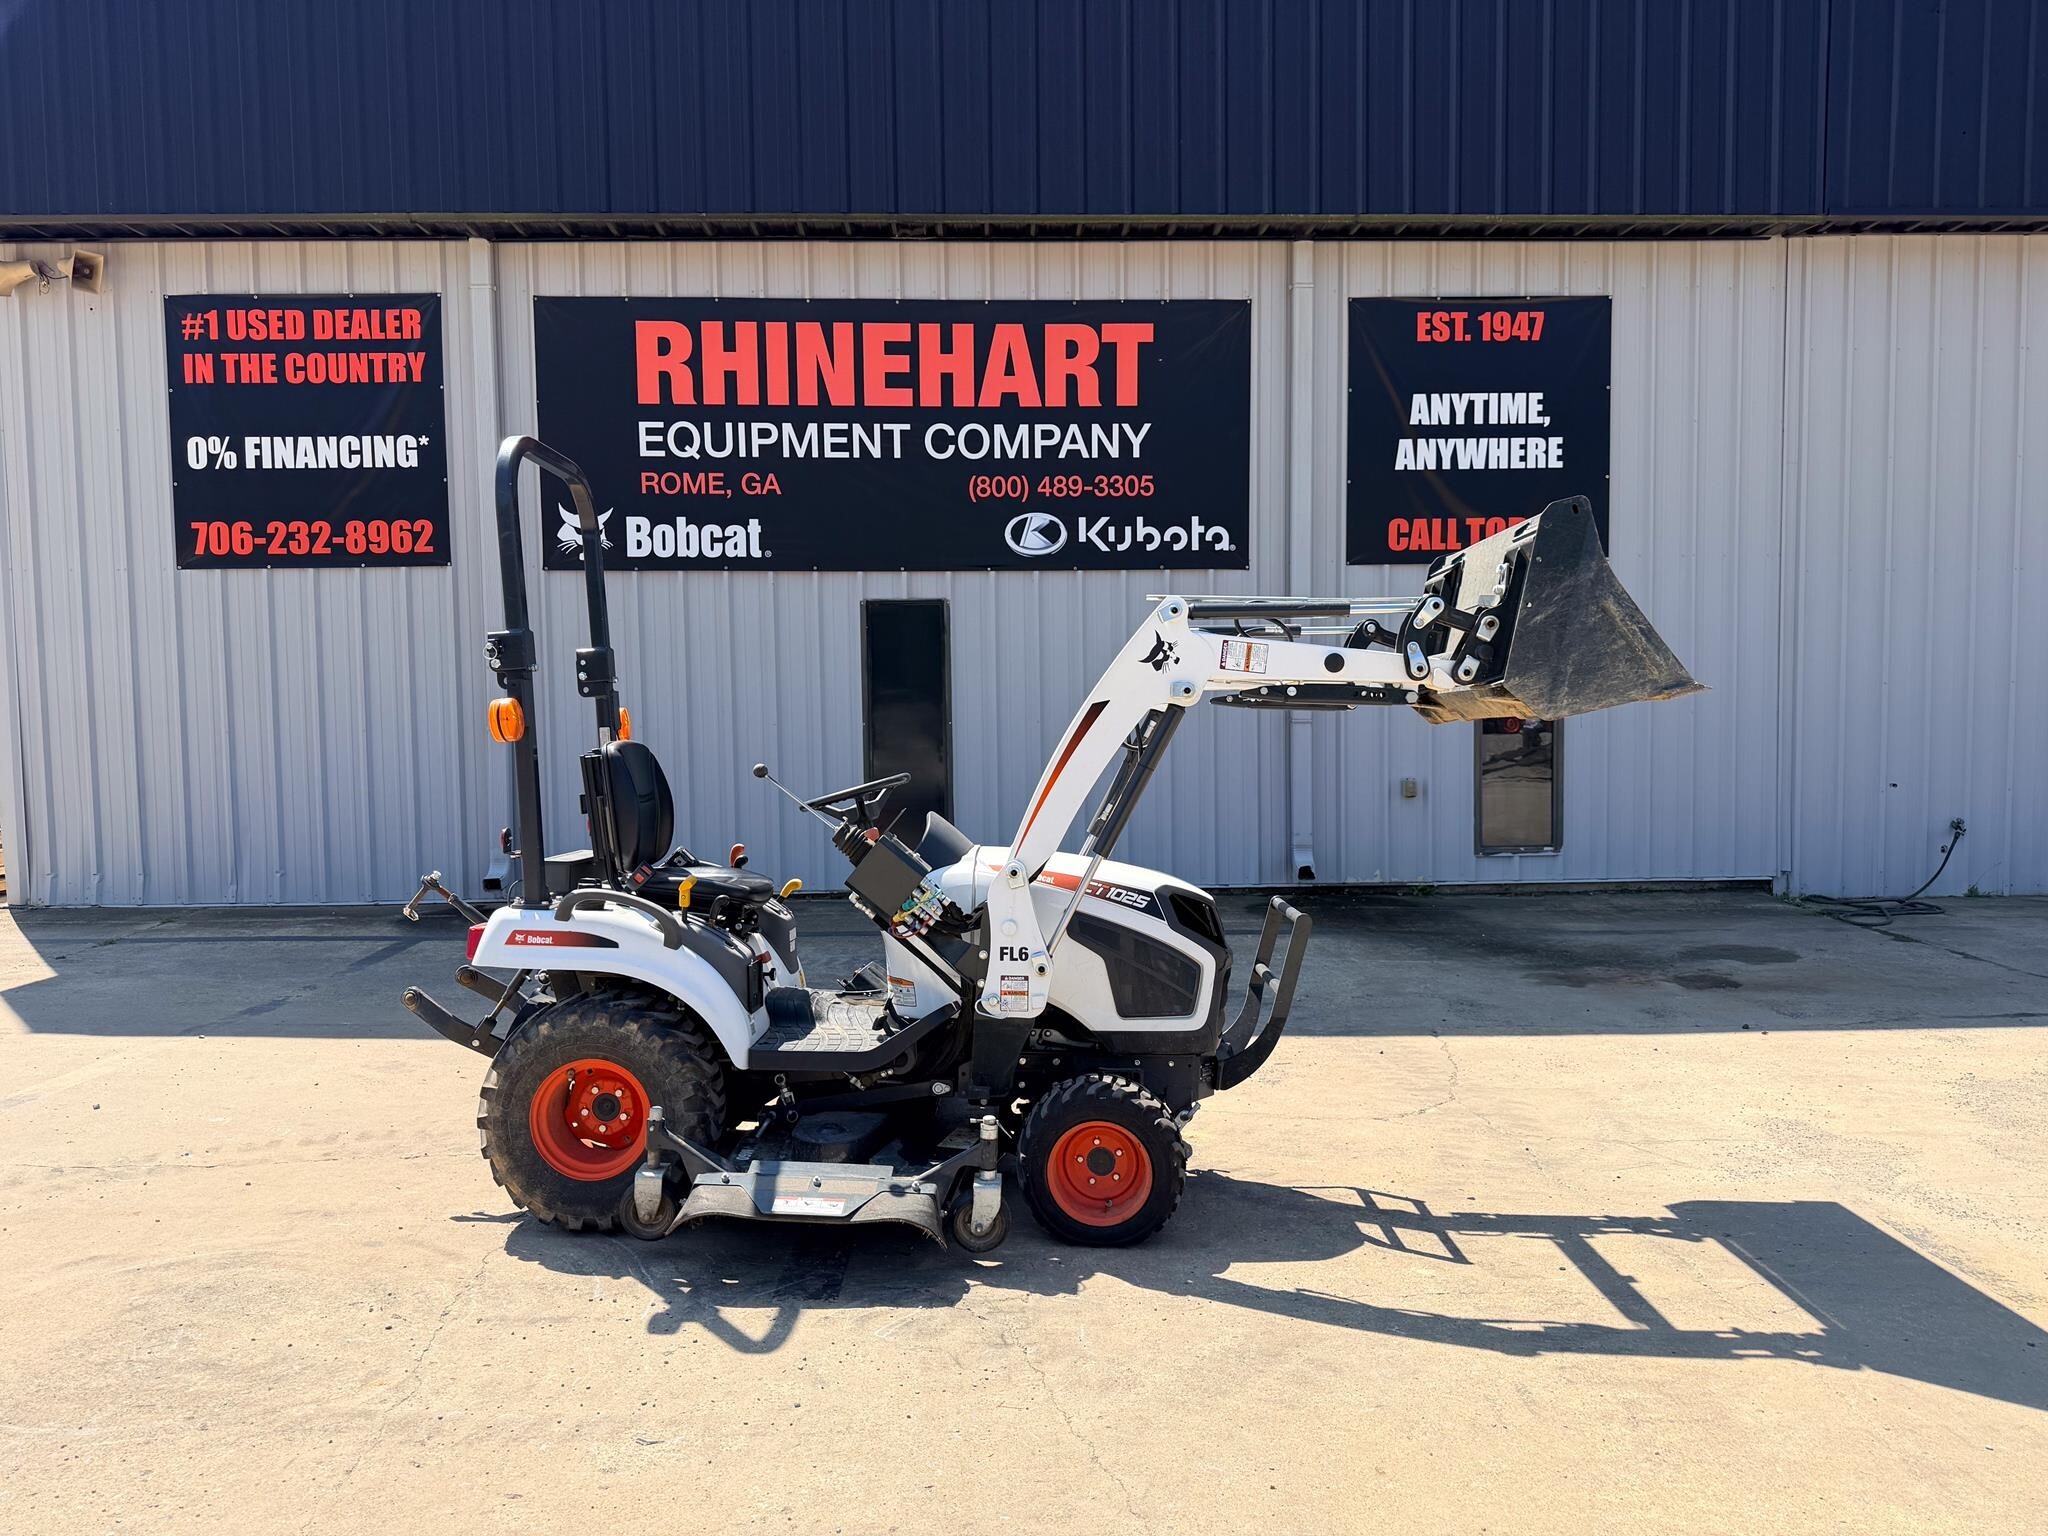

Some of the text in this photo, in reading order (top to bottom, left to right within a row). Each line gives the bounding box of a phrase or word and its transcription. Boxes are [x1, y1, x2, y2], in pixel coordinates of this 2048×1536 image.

[181, 308, 422, 341] #1 USED DEALER
[1416, 311, 1545, 343] EST. 1947
[183, 351, 427, 385] IN THE COUNTRY
[635, 320, 1154, 408] RHINEHART
[1409, 392, 1551, 428] ANYTIME,
[186, 435, 238, 470] 0%
[638, 421, 1152, 460] EQUIPMENT COMPANY
[1394, 436, 1564, 471] ANYWHERE
[640, 472, 782, 498] ROME, GA
[968, 475, 1155, 502] (800) 489-3305
[191, 519, 434, 556] 706-232-8962
[625, 516, 763, 559] Bobcat
[1078, 515, 1230, 552] Kubota
[1387, 517, 1462, 552] CALL
[527, 935, 553, 945] Bobcat
[999, 946, 1029, 962] FL6
